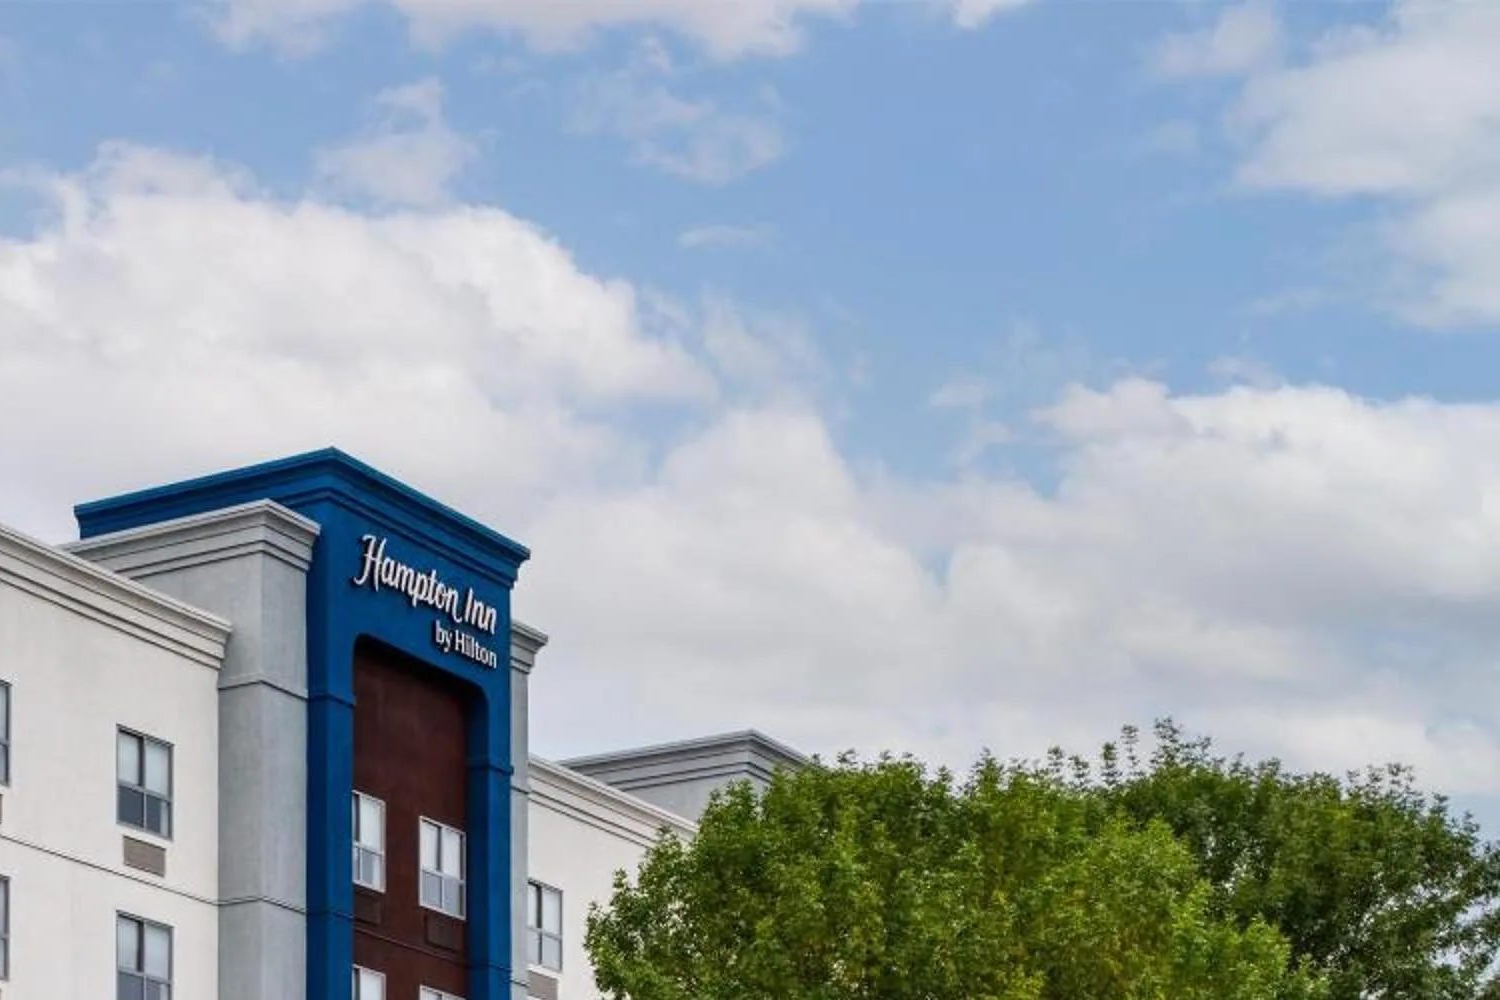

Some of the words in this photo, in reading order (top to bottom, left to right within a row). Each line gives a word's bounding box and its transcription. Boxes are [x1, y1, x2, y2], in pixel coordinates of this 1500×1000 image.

[353, 534, 463, 624] Hampton
[464, 587, 498, 635] Inn
[435, 620, 454, 653] by
[455, 629, 498, 669] Hilton
